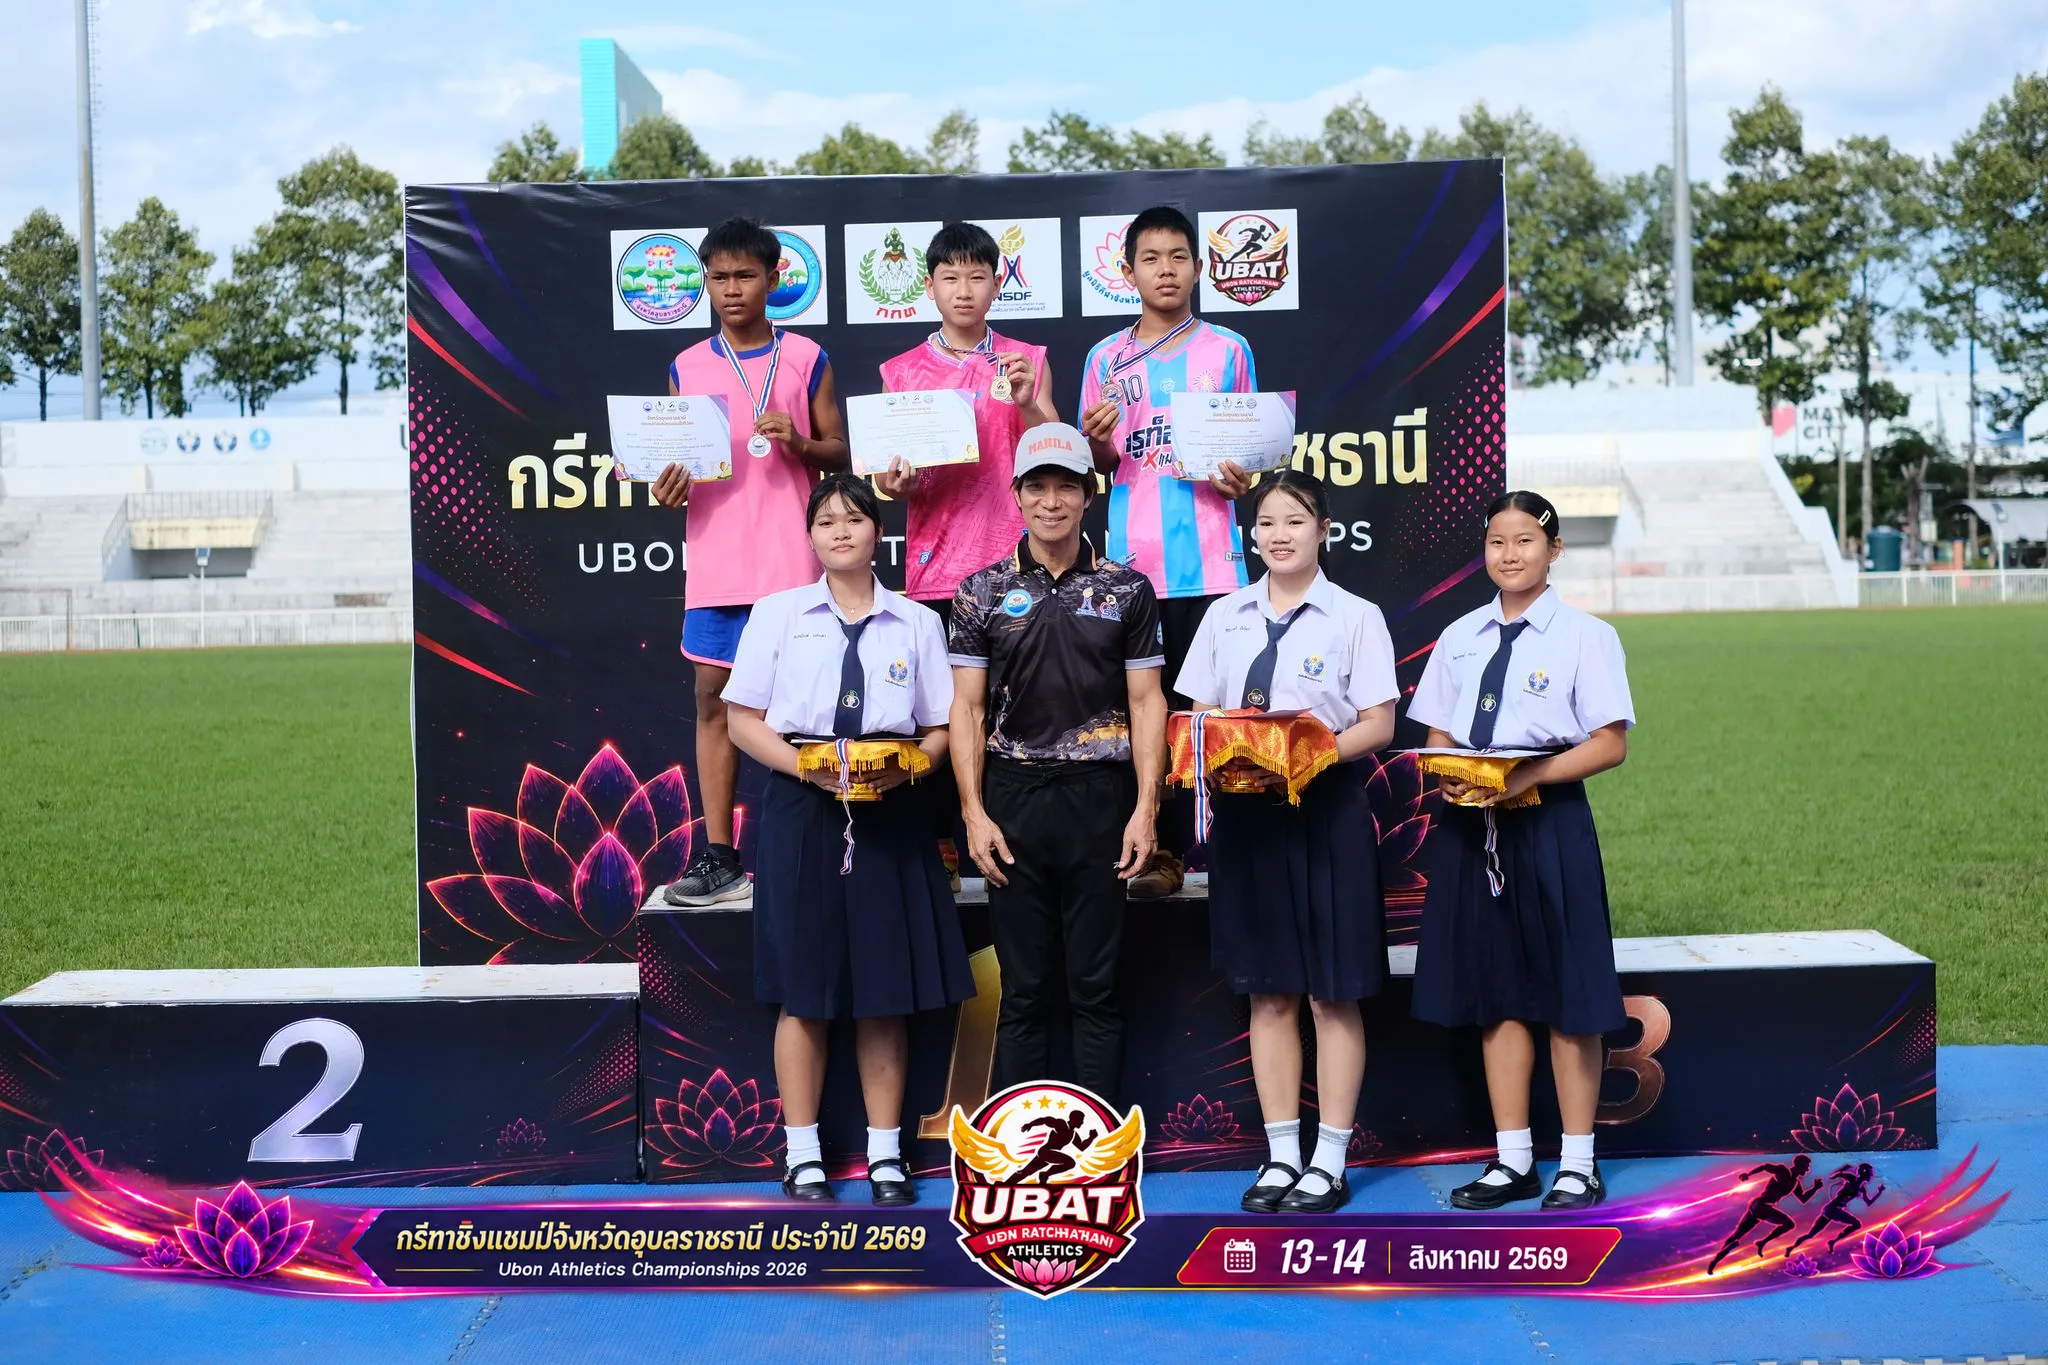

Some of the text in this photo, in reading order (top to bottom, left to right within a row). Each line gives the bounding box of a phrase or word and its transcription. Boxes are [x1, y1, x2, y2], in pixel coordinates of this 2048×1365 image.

[1215, 260, 1283, 280] UBAT
[1119, 374, 1144, 406] 10
[1028, 437, 1072, 455] MANILA
[1592, 995, 1671, 1125] 3
[247, 1017, 364, 1162] 2
